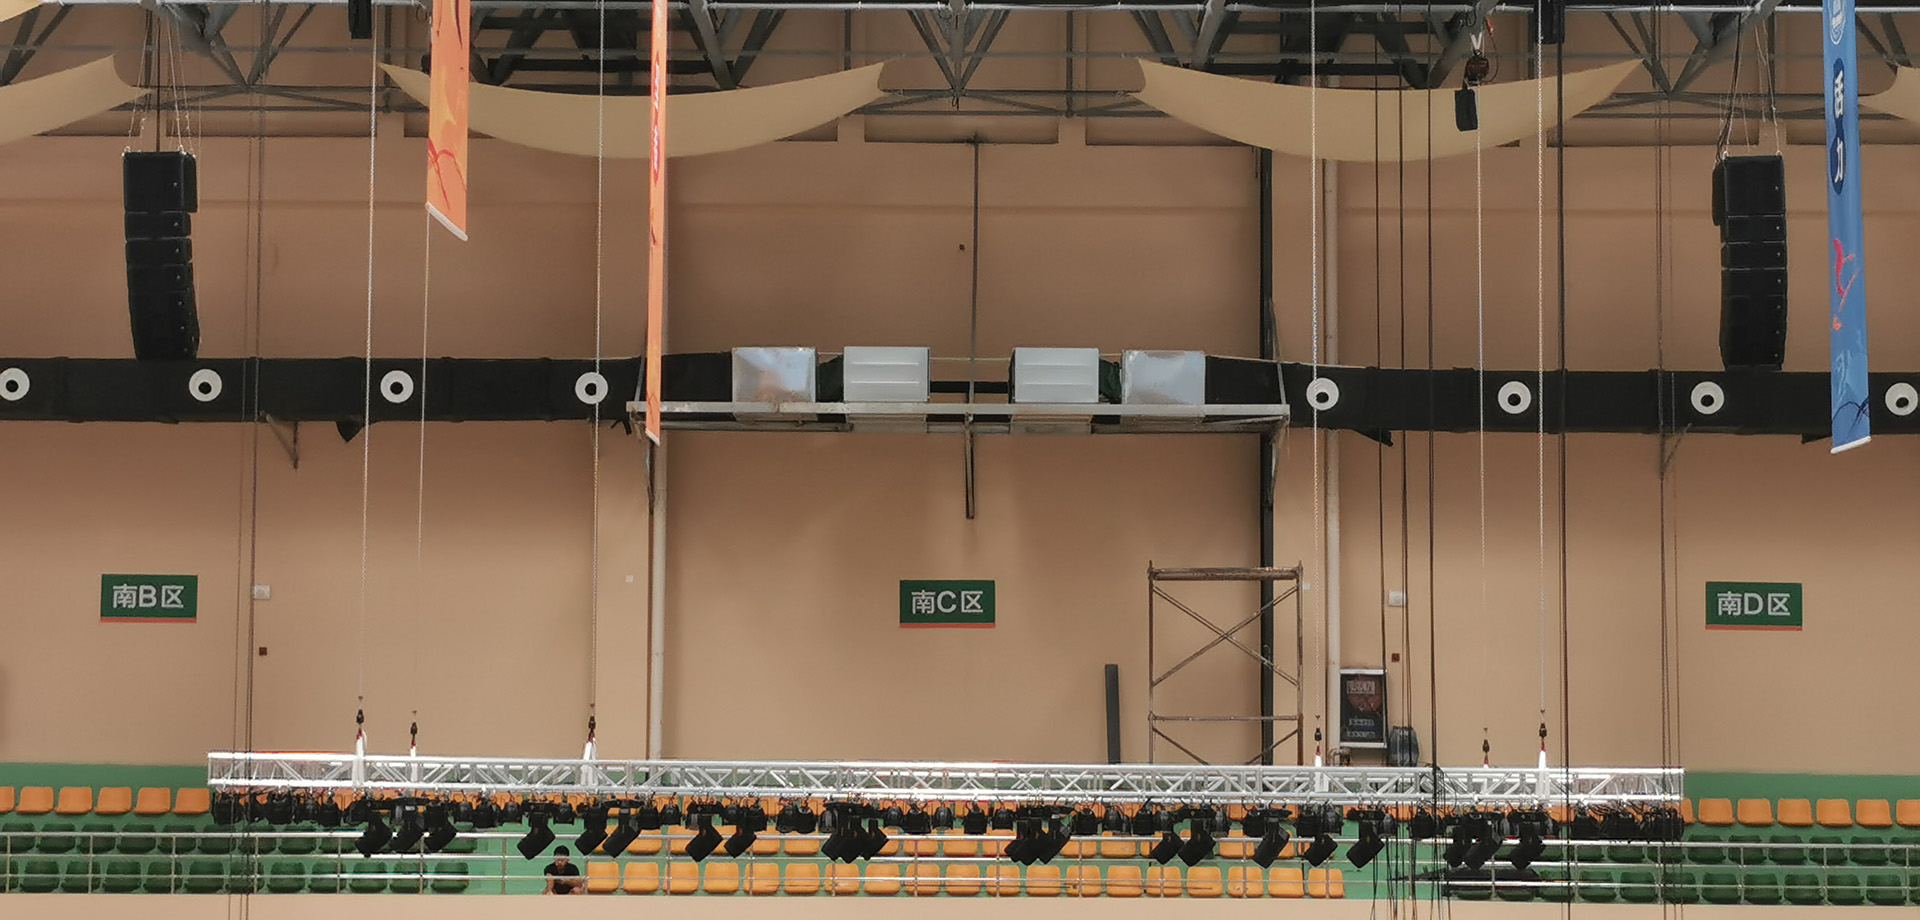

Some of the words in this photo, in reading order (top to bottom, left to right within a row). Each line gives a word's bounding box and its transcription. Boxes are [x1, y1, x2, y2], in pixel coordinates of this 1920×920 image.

[112, 583, 185, 609] 南B区
[911, 589, 984, 615] 南C区
[1716, 590, 1791, 616] 南D区
